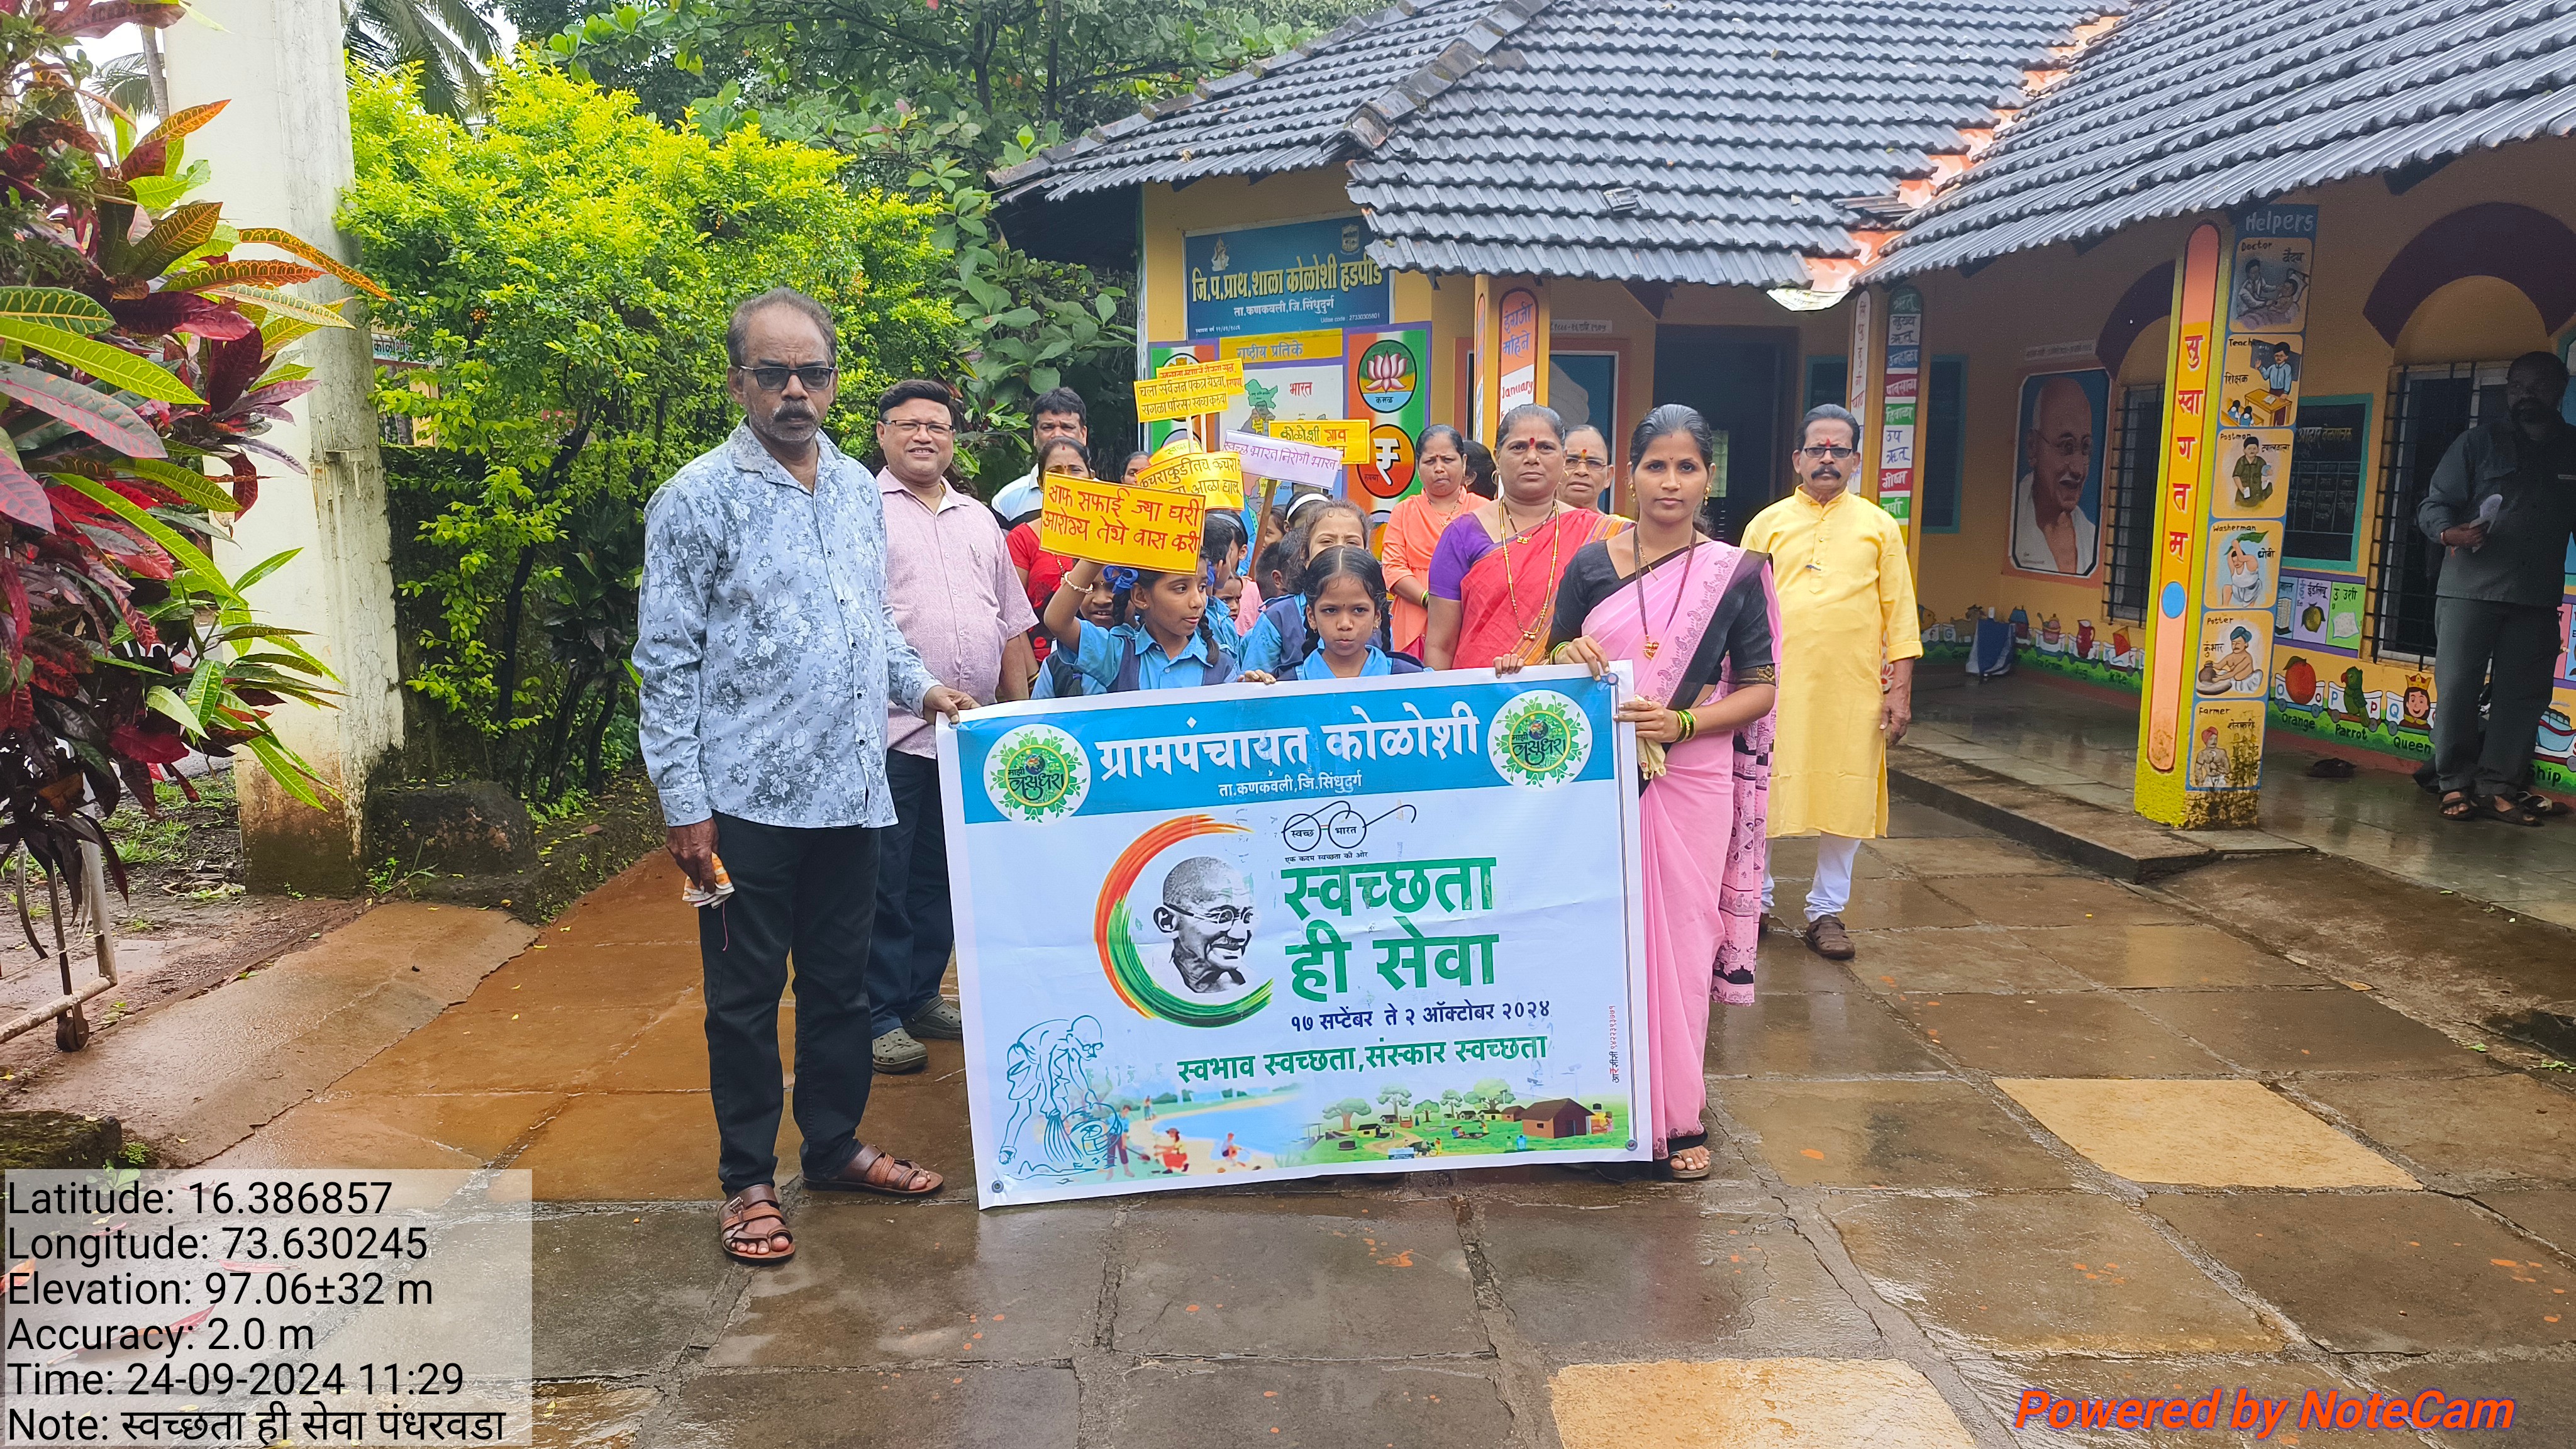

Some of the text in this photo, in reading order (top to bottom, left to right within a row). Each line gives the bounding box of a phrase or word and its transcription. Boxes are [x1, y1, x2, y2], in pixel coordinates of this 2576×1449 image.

[2245, 211, 2314, 234] Helpers
[2241, 240, 2272, 252] Doctor
[1286, 253, 1336, 292] कोळोशी
[2224, 372, 2249, 386] शिक्षक
[1139, 385, 1157, 397] चला
[1289, 382, 1313, 397] भारत
[1502, 380, 1533, 399] January
[1141, 402, 1166, 415] सगळा
[1167, 397, 1192, 412] परिसर
[1250, 445, 1278, 462] भारत
[1279, 447, 1310, 465] निरोगी
[1311, 456, 1338, 470] भारत
[1049, 484, 1202, 526] साफ सफाई ज्या घरी
[1043, 507, 1201, 553] आरोग्य तेथे वास करी
[2213, 524, 2257, 532] Washerman
[2331, 691, 2338, 705] P
[2199, 707, 2231, 715] Farmer
[2389, 703, 2399, 719] Q
[1512, 732, 1528, 742] माझी
[2334, 724, 2368, 740] Parrot
[1094, 700, 1480, 782] ग्रामपंचायत कोळोशी
[2393, 736, 2432, 755] Queen
[1008, 767, 1024, 777] माझी
[1291, 826, 1357, 838] स्वच्छ भारत
[1284, 856, 1296, 865] एक
[1280, 857, 1497, 921] स्वच्छता
[1285, 915, 1499, 1002] ही सेवा
[1291, 998, 1551, 1032] १७ सप्टेंबर ते २ ऑक्टोबर २०२४
[1177, 1055, 1255, 1084] स्वभाव
[1454, 1035, 1548, 1063] स्वच्छता
